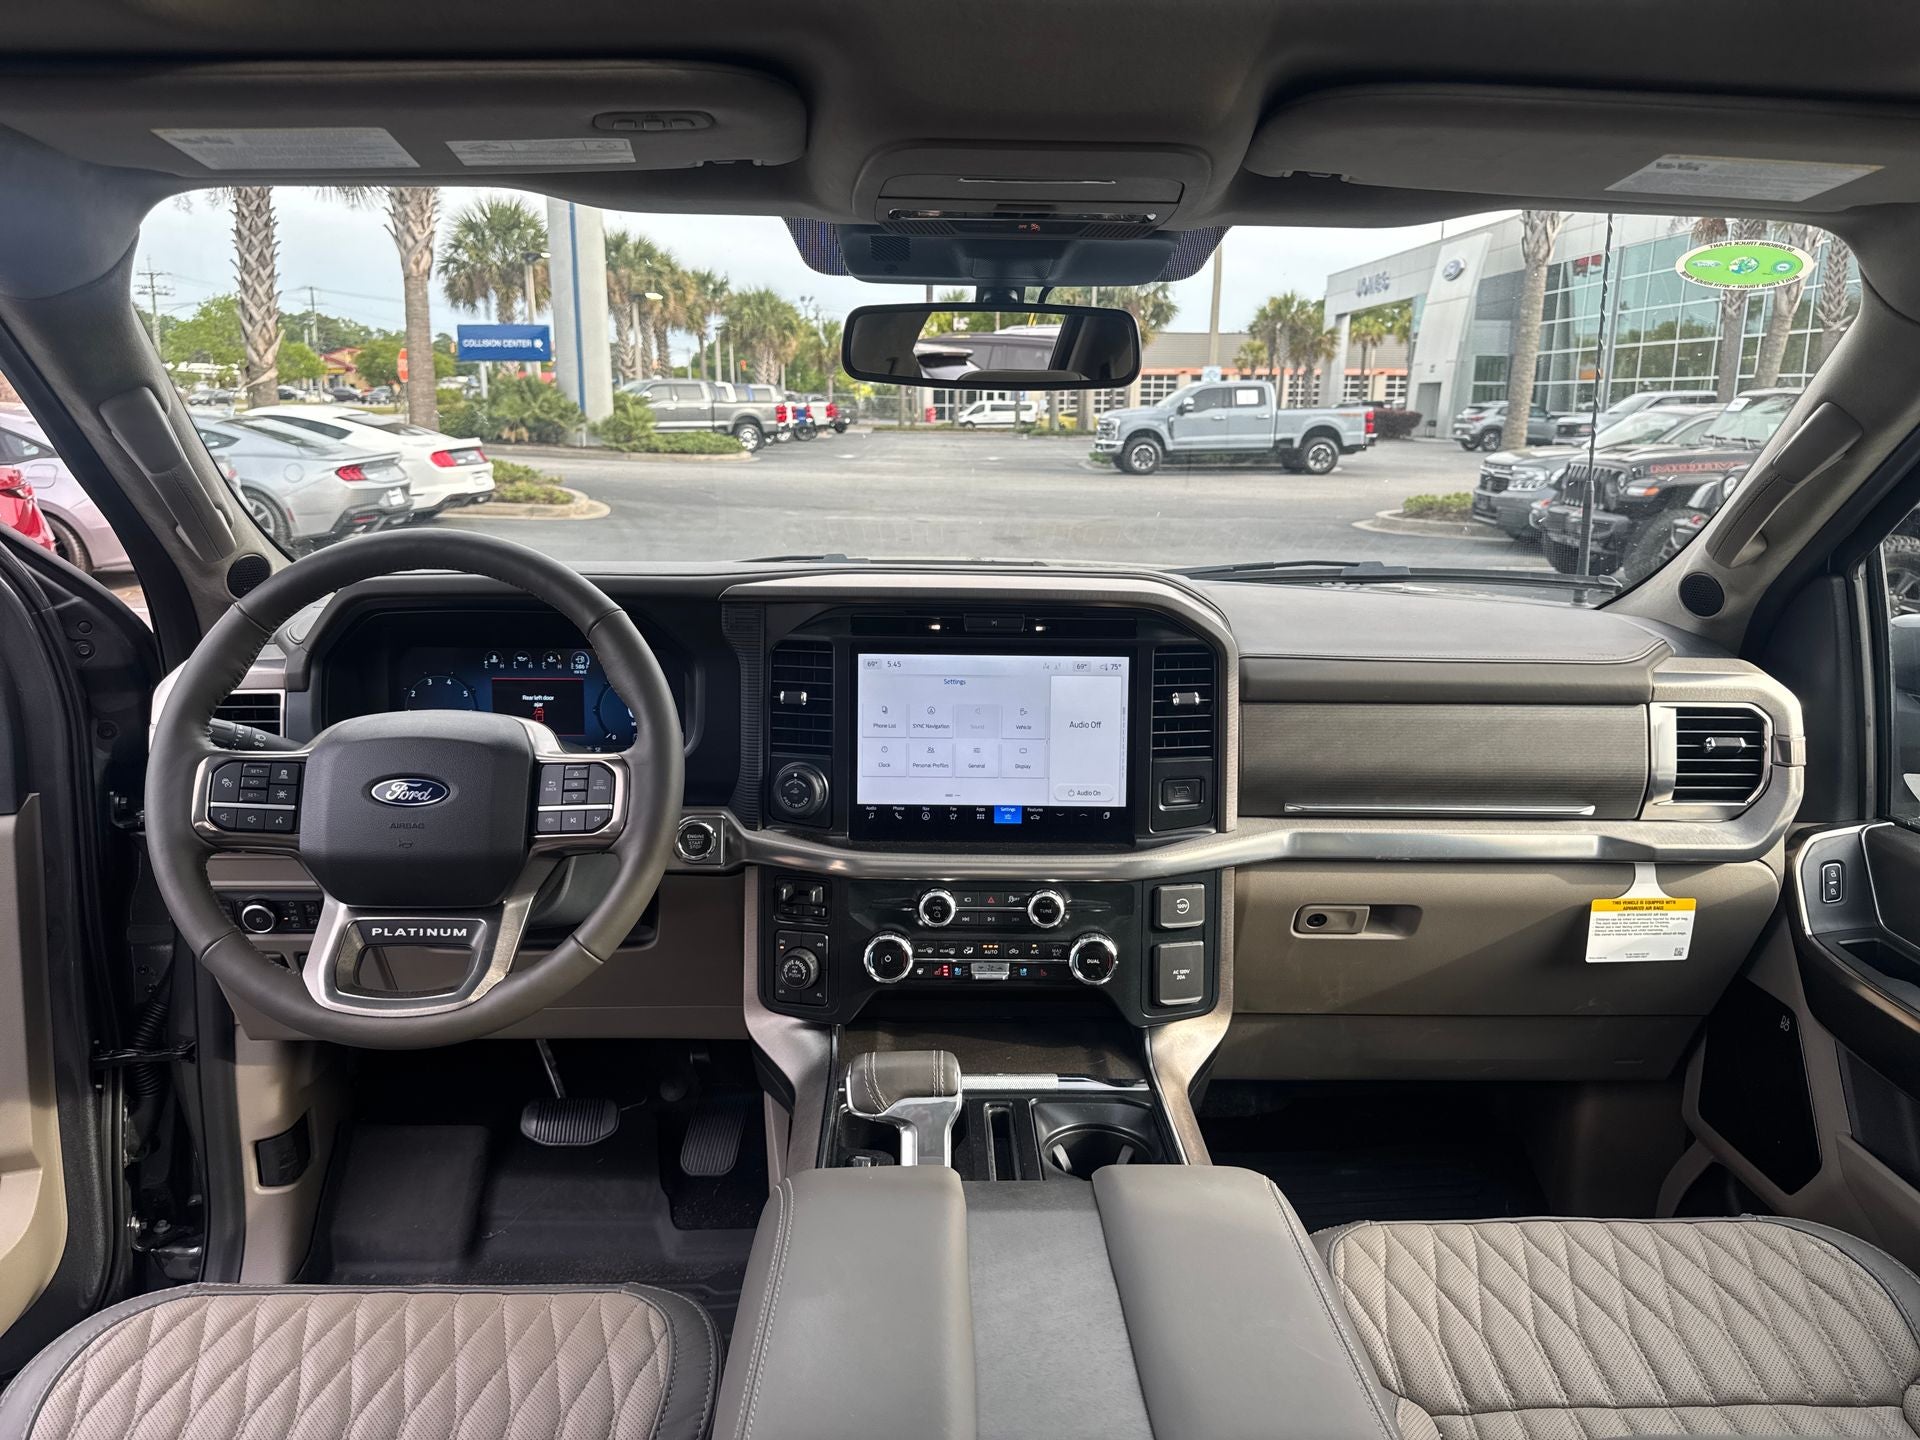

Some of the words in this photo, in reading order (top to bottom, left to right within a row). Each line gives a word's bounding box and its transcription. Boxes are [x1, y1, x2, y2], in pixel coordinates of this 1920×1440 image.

[462, 338, 502, 348] COLLISION
[502, 339, 532, 348] CENTER
[943, 678, 966, 686] Settings
[385, 782, 433, 801] Ford
[371, 928, 468, 937] PLATINUM
[784, 960, 794, 972] DRIVE
[795, 960, 806, 973] MODE
